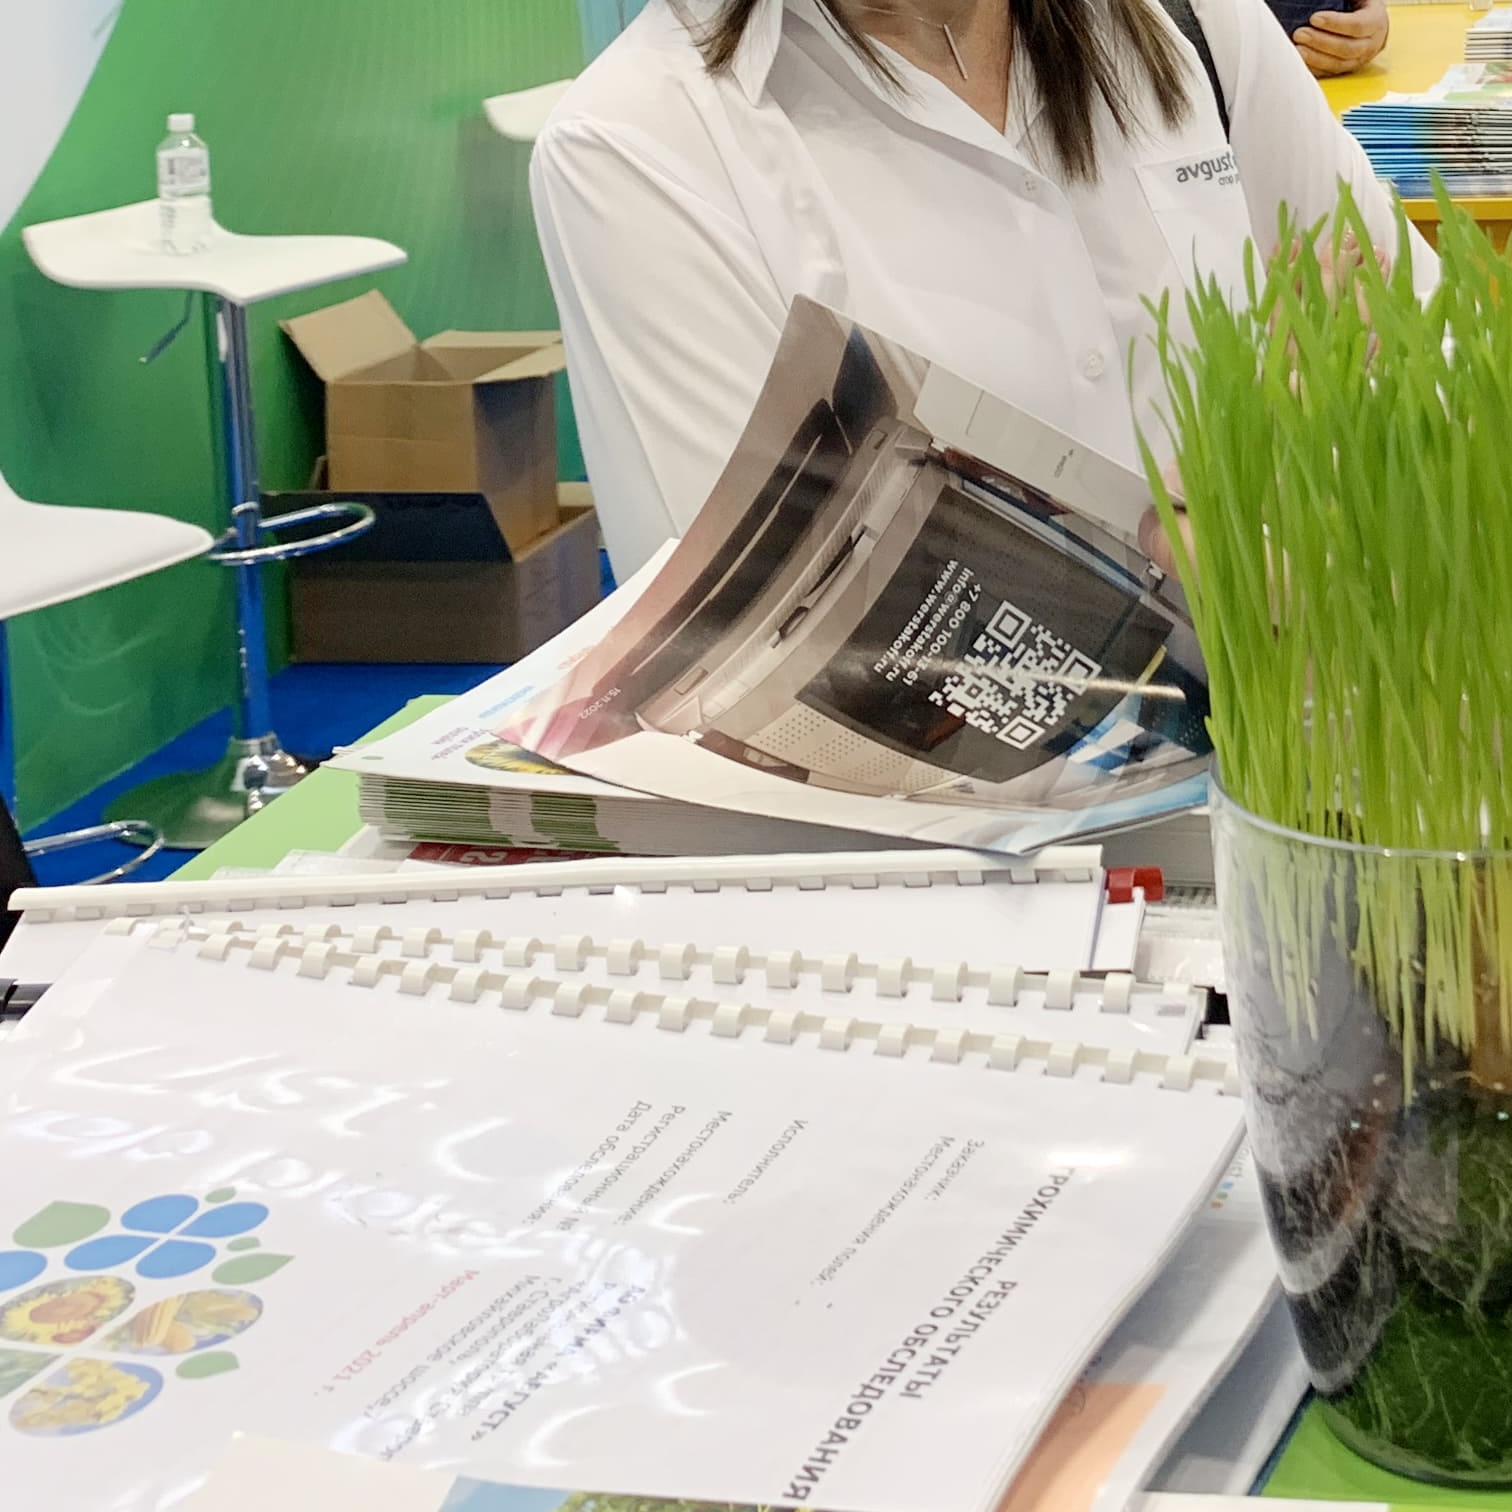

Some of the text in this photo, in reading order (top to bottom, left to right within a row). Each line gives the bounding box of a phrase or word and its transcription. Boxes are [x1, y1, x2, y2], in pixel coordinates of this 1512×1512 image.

[949, 600, 971, 629] 800
[782, 1168, 1075, 1501] ГРОХИМИЧЕСКОГО ОБСЛЕДОВАНИЯ
[900, 1278, 1018, 1400] РЕЗУЛЬТАТЫ
